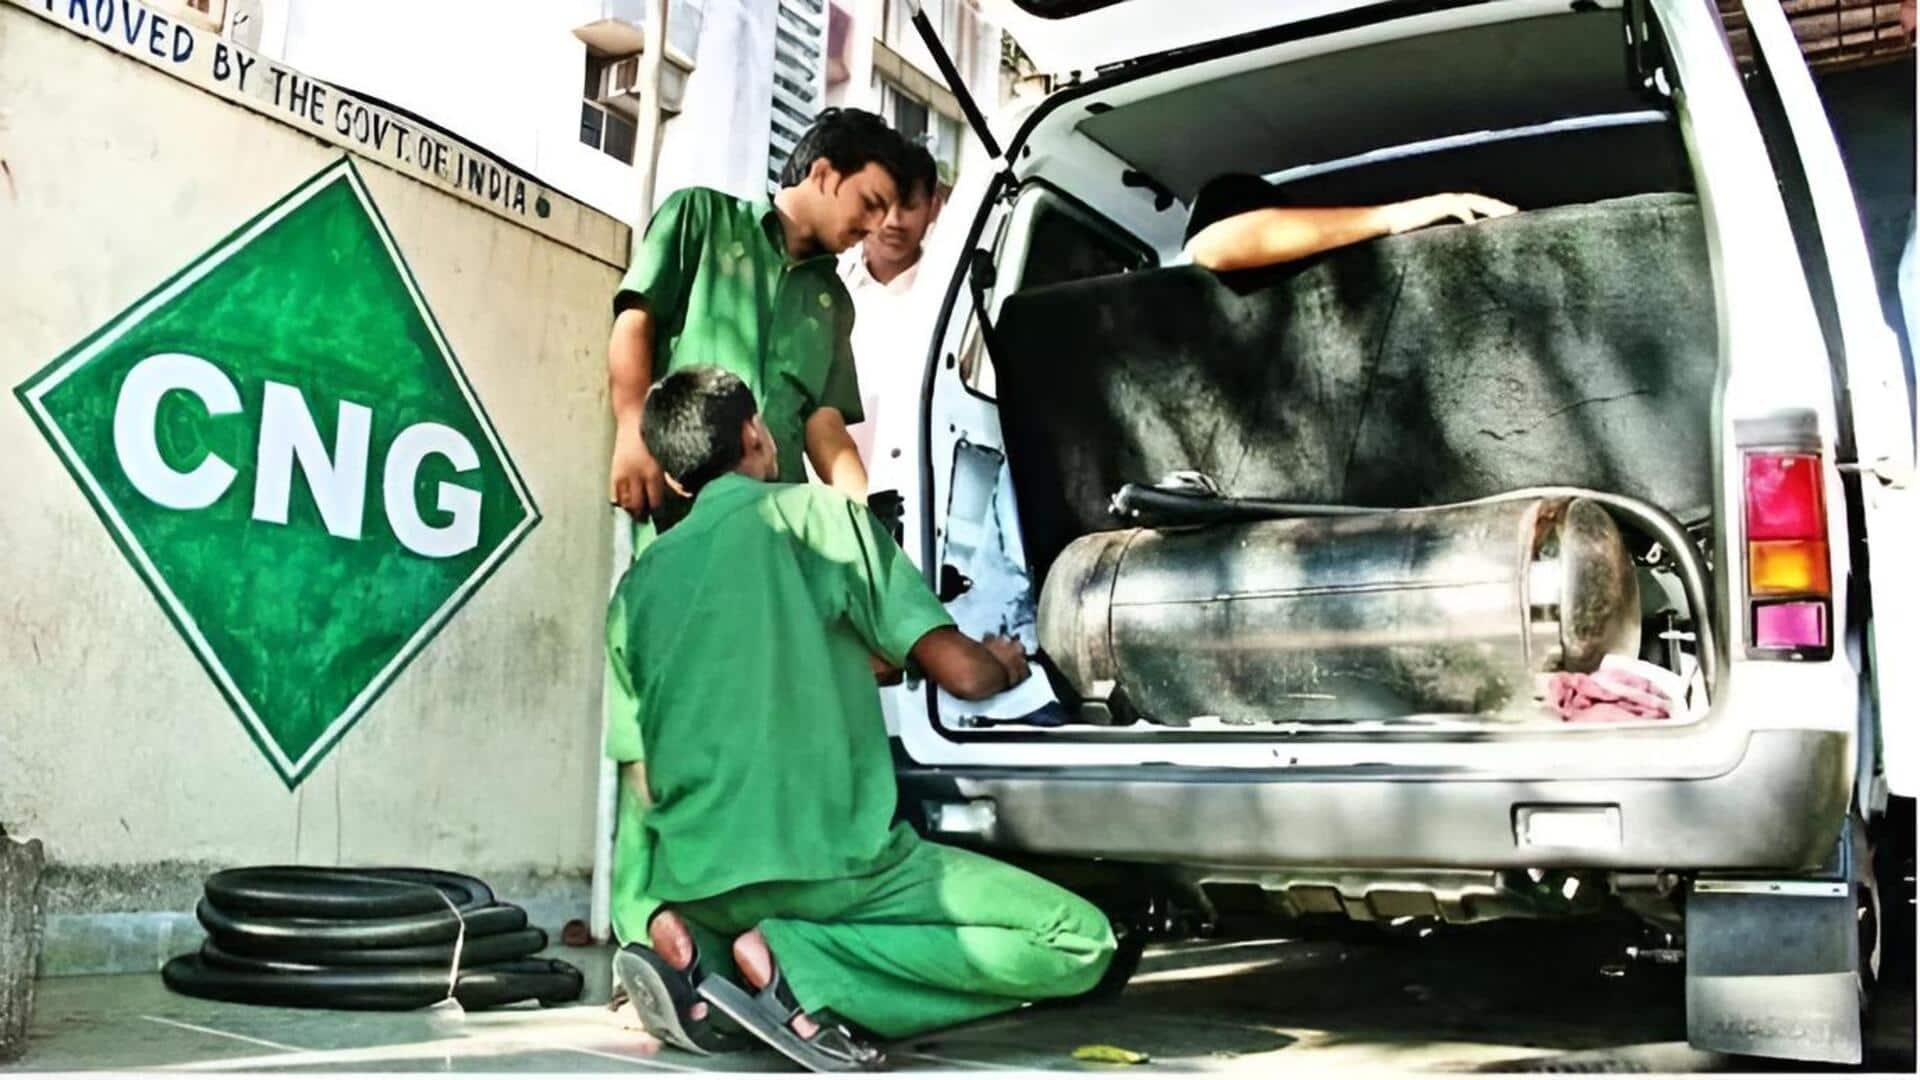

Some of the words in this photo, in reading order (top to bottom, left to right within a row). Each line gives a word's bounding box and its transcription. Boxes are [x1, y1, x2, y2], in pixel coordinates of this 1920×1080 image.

[46, 0, 194, 63] ROVED
[213, 43, 256, 91] BY
[269, 66, 326, 125] THE
[335, 99, 411, 163] GOVT.
[419, 135, 449, 175] OF
[453, 152, 526, 216] INDIA
[113, 352, 483, 558] CNG
